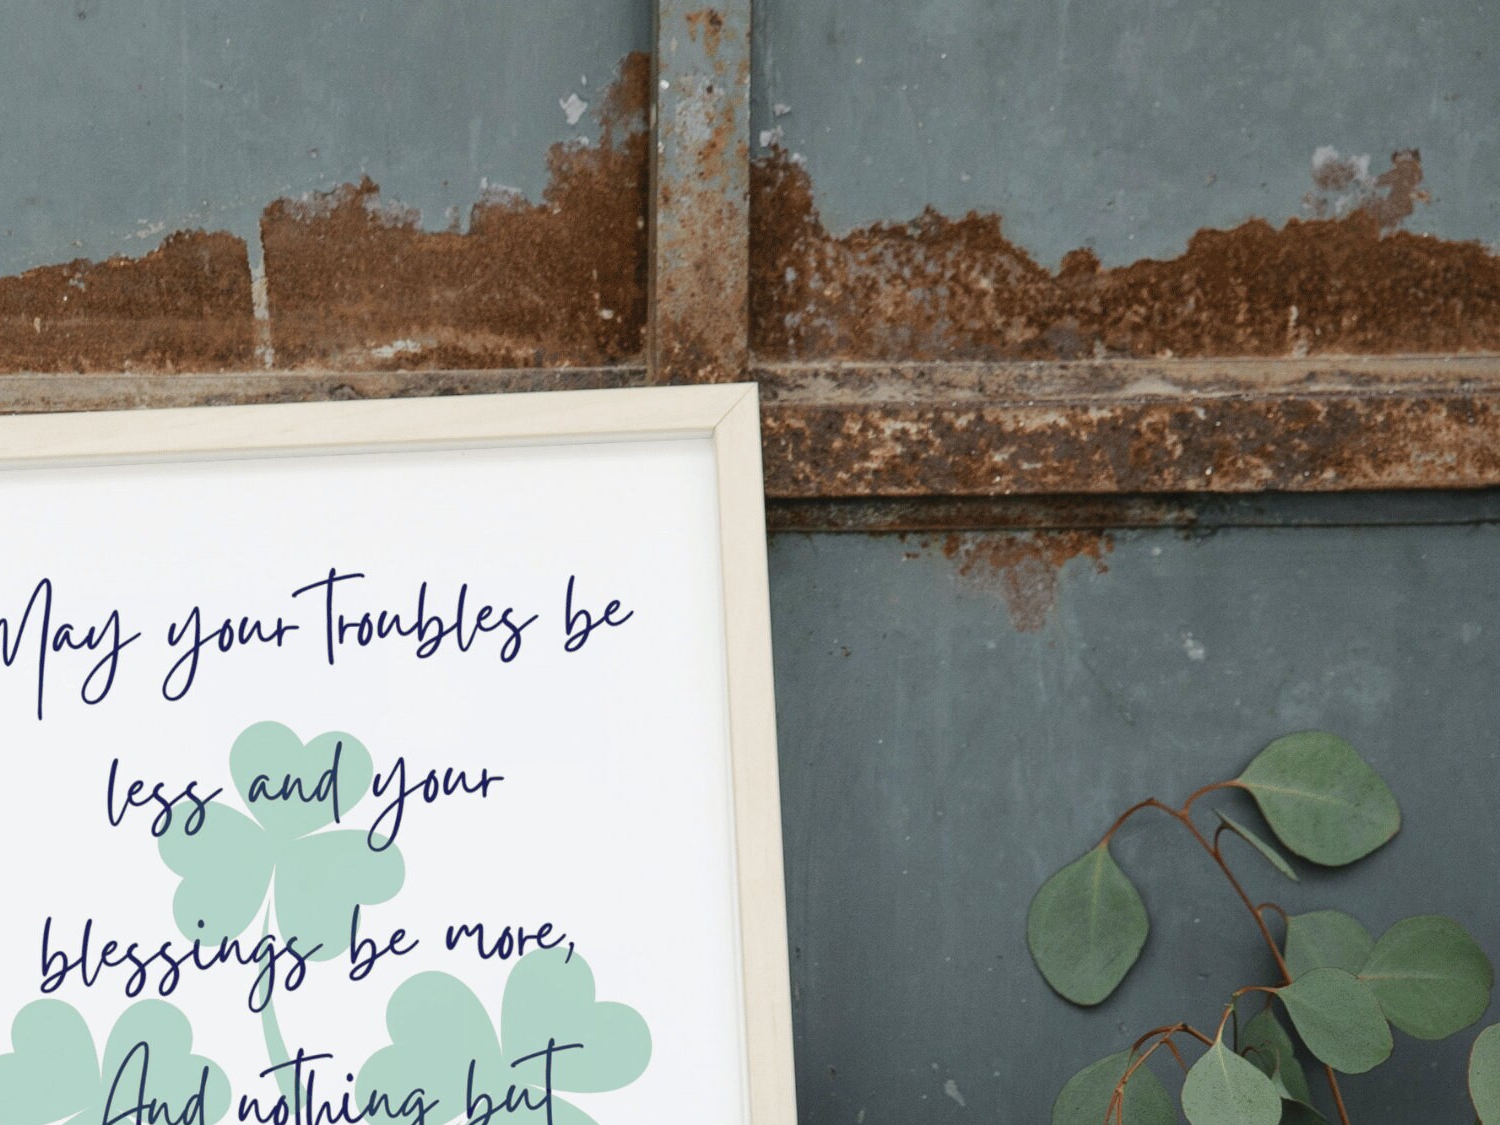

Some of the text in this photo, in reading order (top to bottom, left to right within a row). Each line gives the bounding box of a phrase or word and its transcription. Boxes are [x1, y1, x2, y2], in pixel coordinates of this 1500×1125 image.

[161, 605, 300, 702] your
[291, 566, 540, 665] troubles
[563, 574, 635, 653] be
[106, 740, 505, 853] less and your
[39, 903, 576, 1014] blessings be more,
